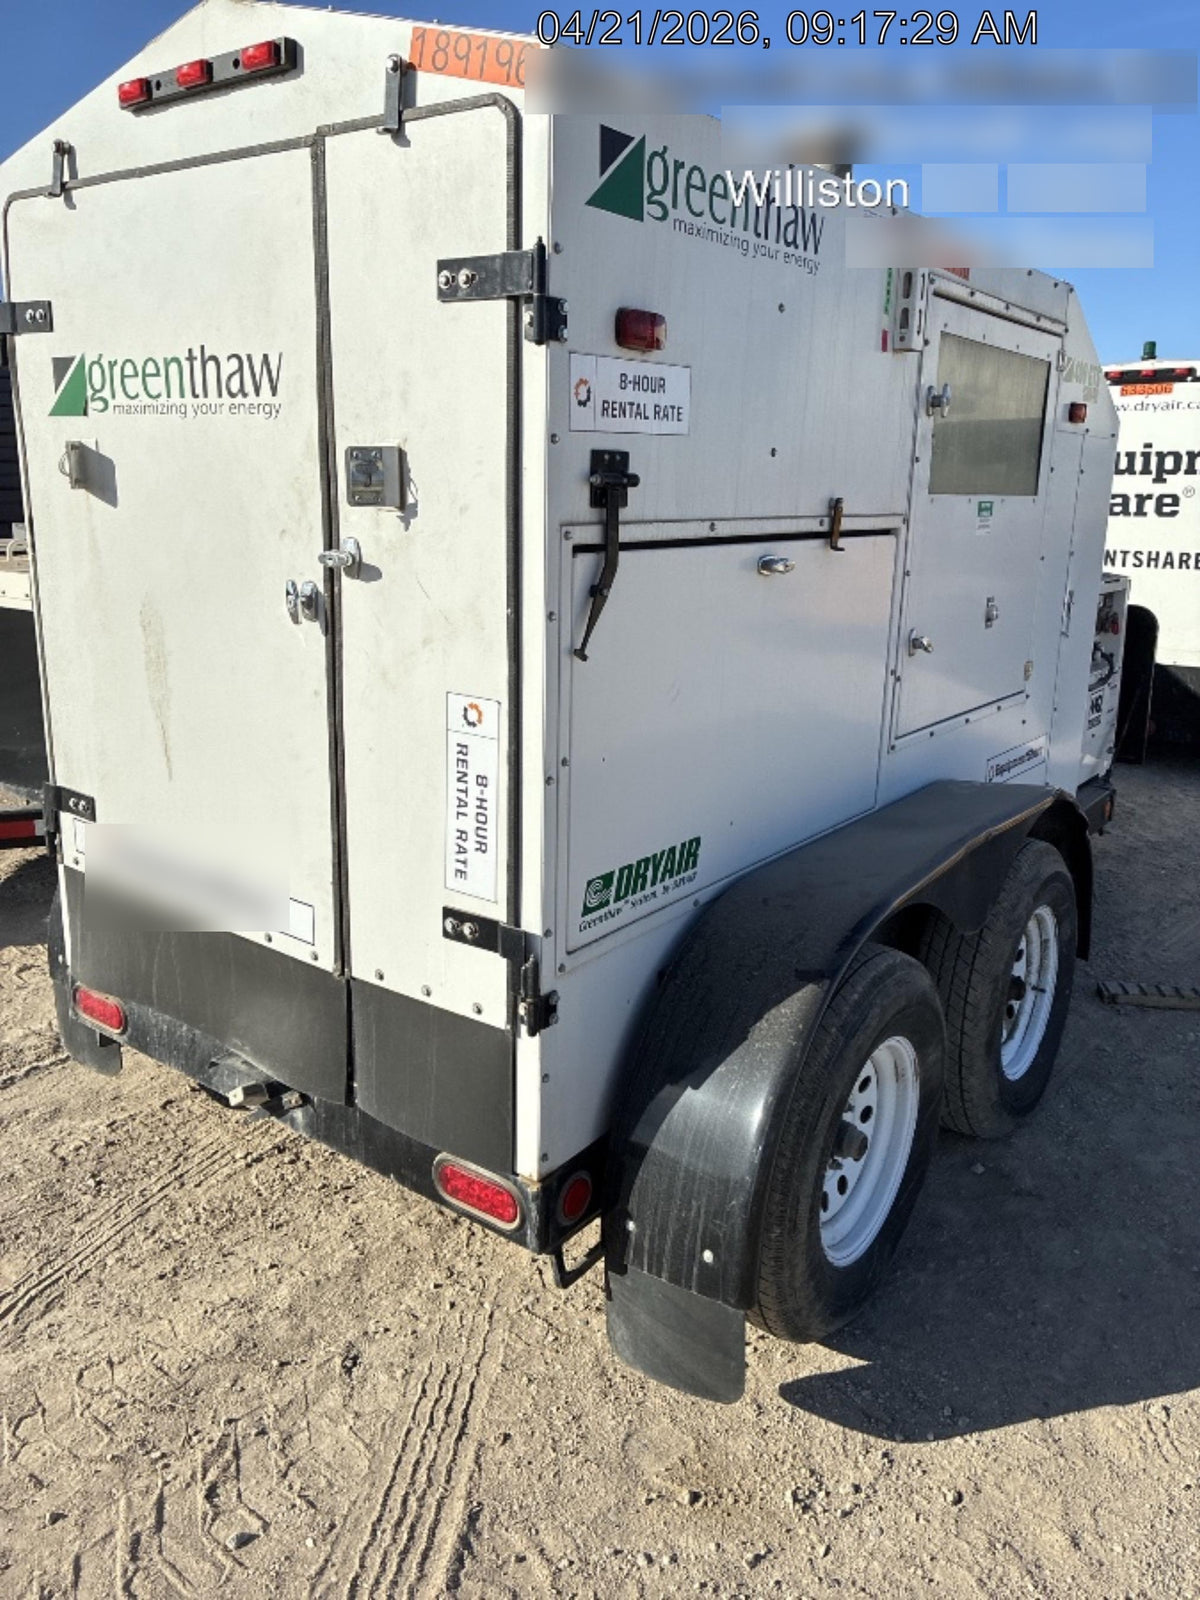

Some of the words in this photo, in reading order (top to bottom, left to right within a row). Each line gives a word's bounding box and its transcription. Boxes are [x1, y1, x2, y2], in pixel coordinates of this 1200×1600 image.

[672, 217, 749, 257] maximizing
[752, 242, 780, 259] your
[783, 251, 821, 276] energy
[88, 344, 283, 413] greenthaw
[620, 372, 666, 394] 8-HOUR
[113, 400, 187, 417] maximizing
[192, 401, 225, 418] your
[228, 401, 282, 419] energy
[601, 400, 650, 420] RENTAL
[653, 404, 684, 422] RATE
[456, 742, 469, 820] RENTAL
[474, 774, 488, 854] 8-HOUR
[455, 829, 469, 880] RATE
[613, 836, 701, 903] DRYAIR
